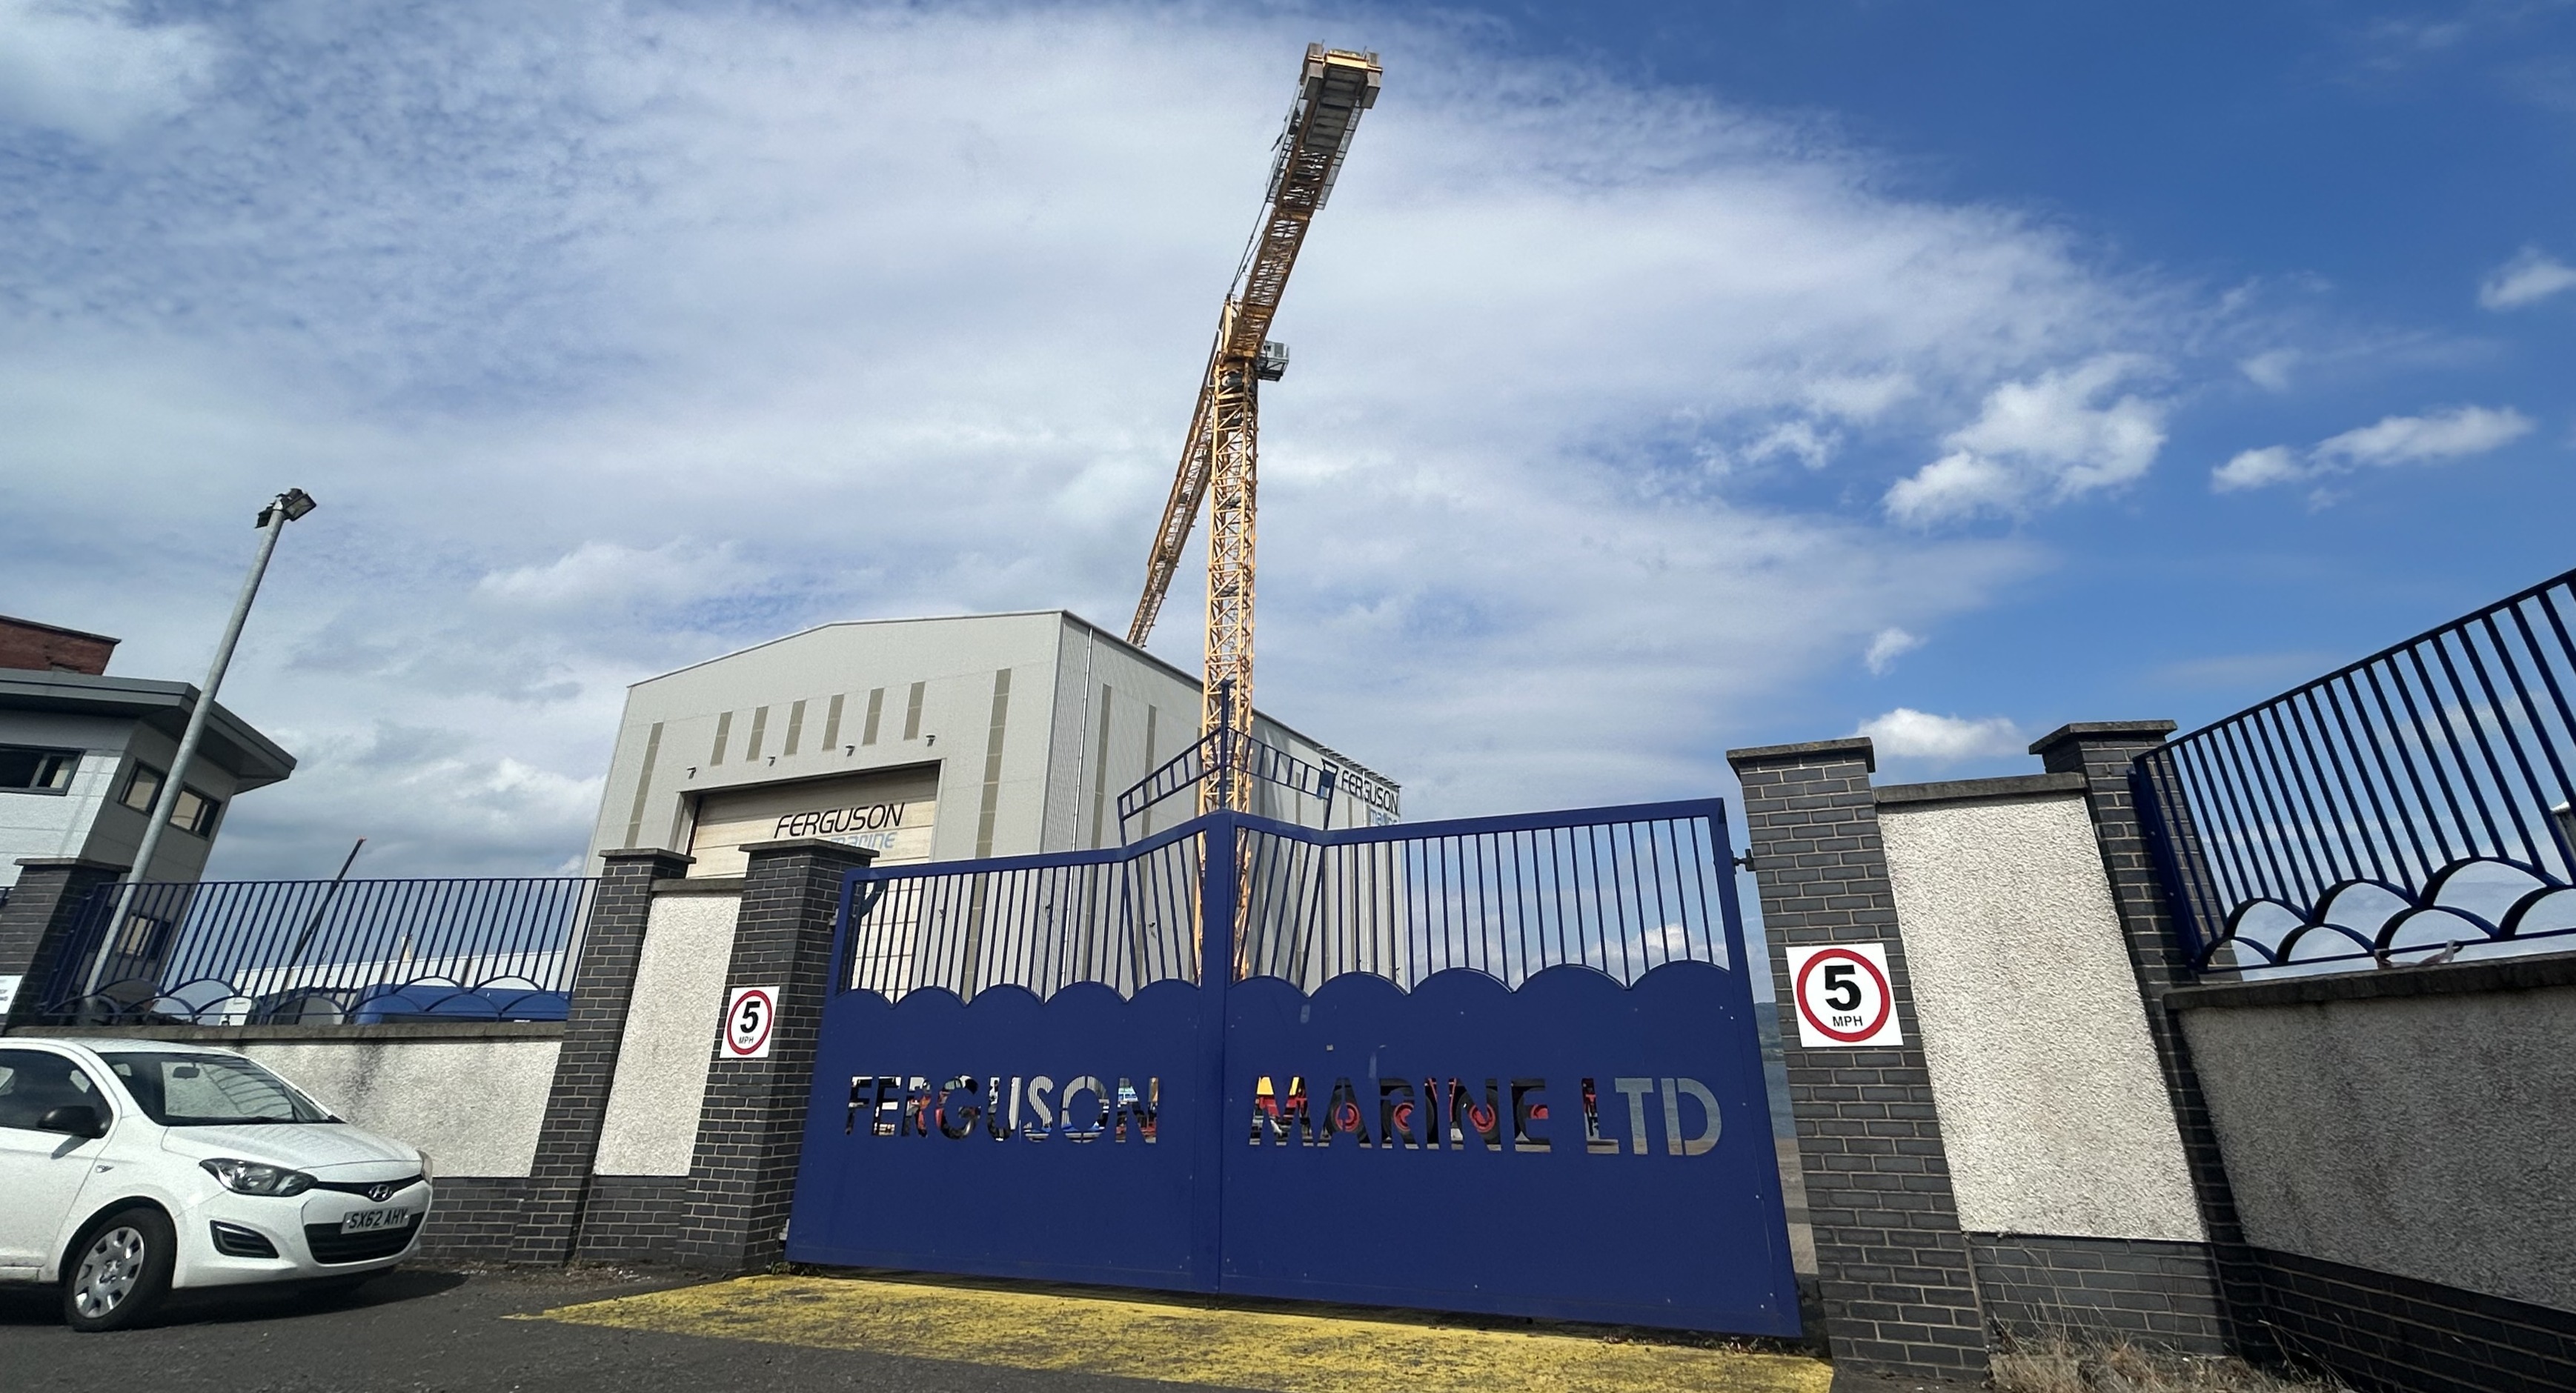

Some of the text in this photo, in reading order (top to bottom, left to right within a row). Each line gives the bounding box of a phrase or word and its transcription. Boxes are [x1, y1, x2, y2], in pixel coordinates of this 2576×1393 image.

[1341, 770, 1398, 815] FERGUSON
[774, 802, 906, 839] FERGUSON
[1825, 965, 1862, 1011] 5
[740, 1001, 760, 1033] 5
[1832, 1015, 1863, 1027] MPH
[739, 1036, 754, 1044] MPH
[844, 1074, 1722, 1156] FERGUSON MARINE LTD
[348, 1208, 409, 1229] SX62 AHY
